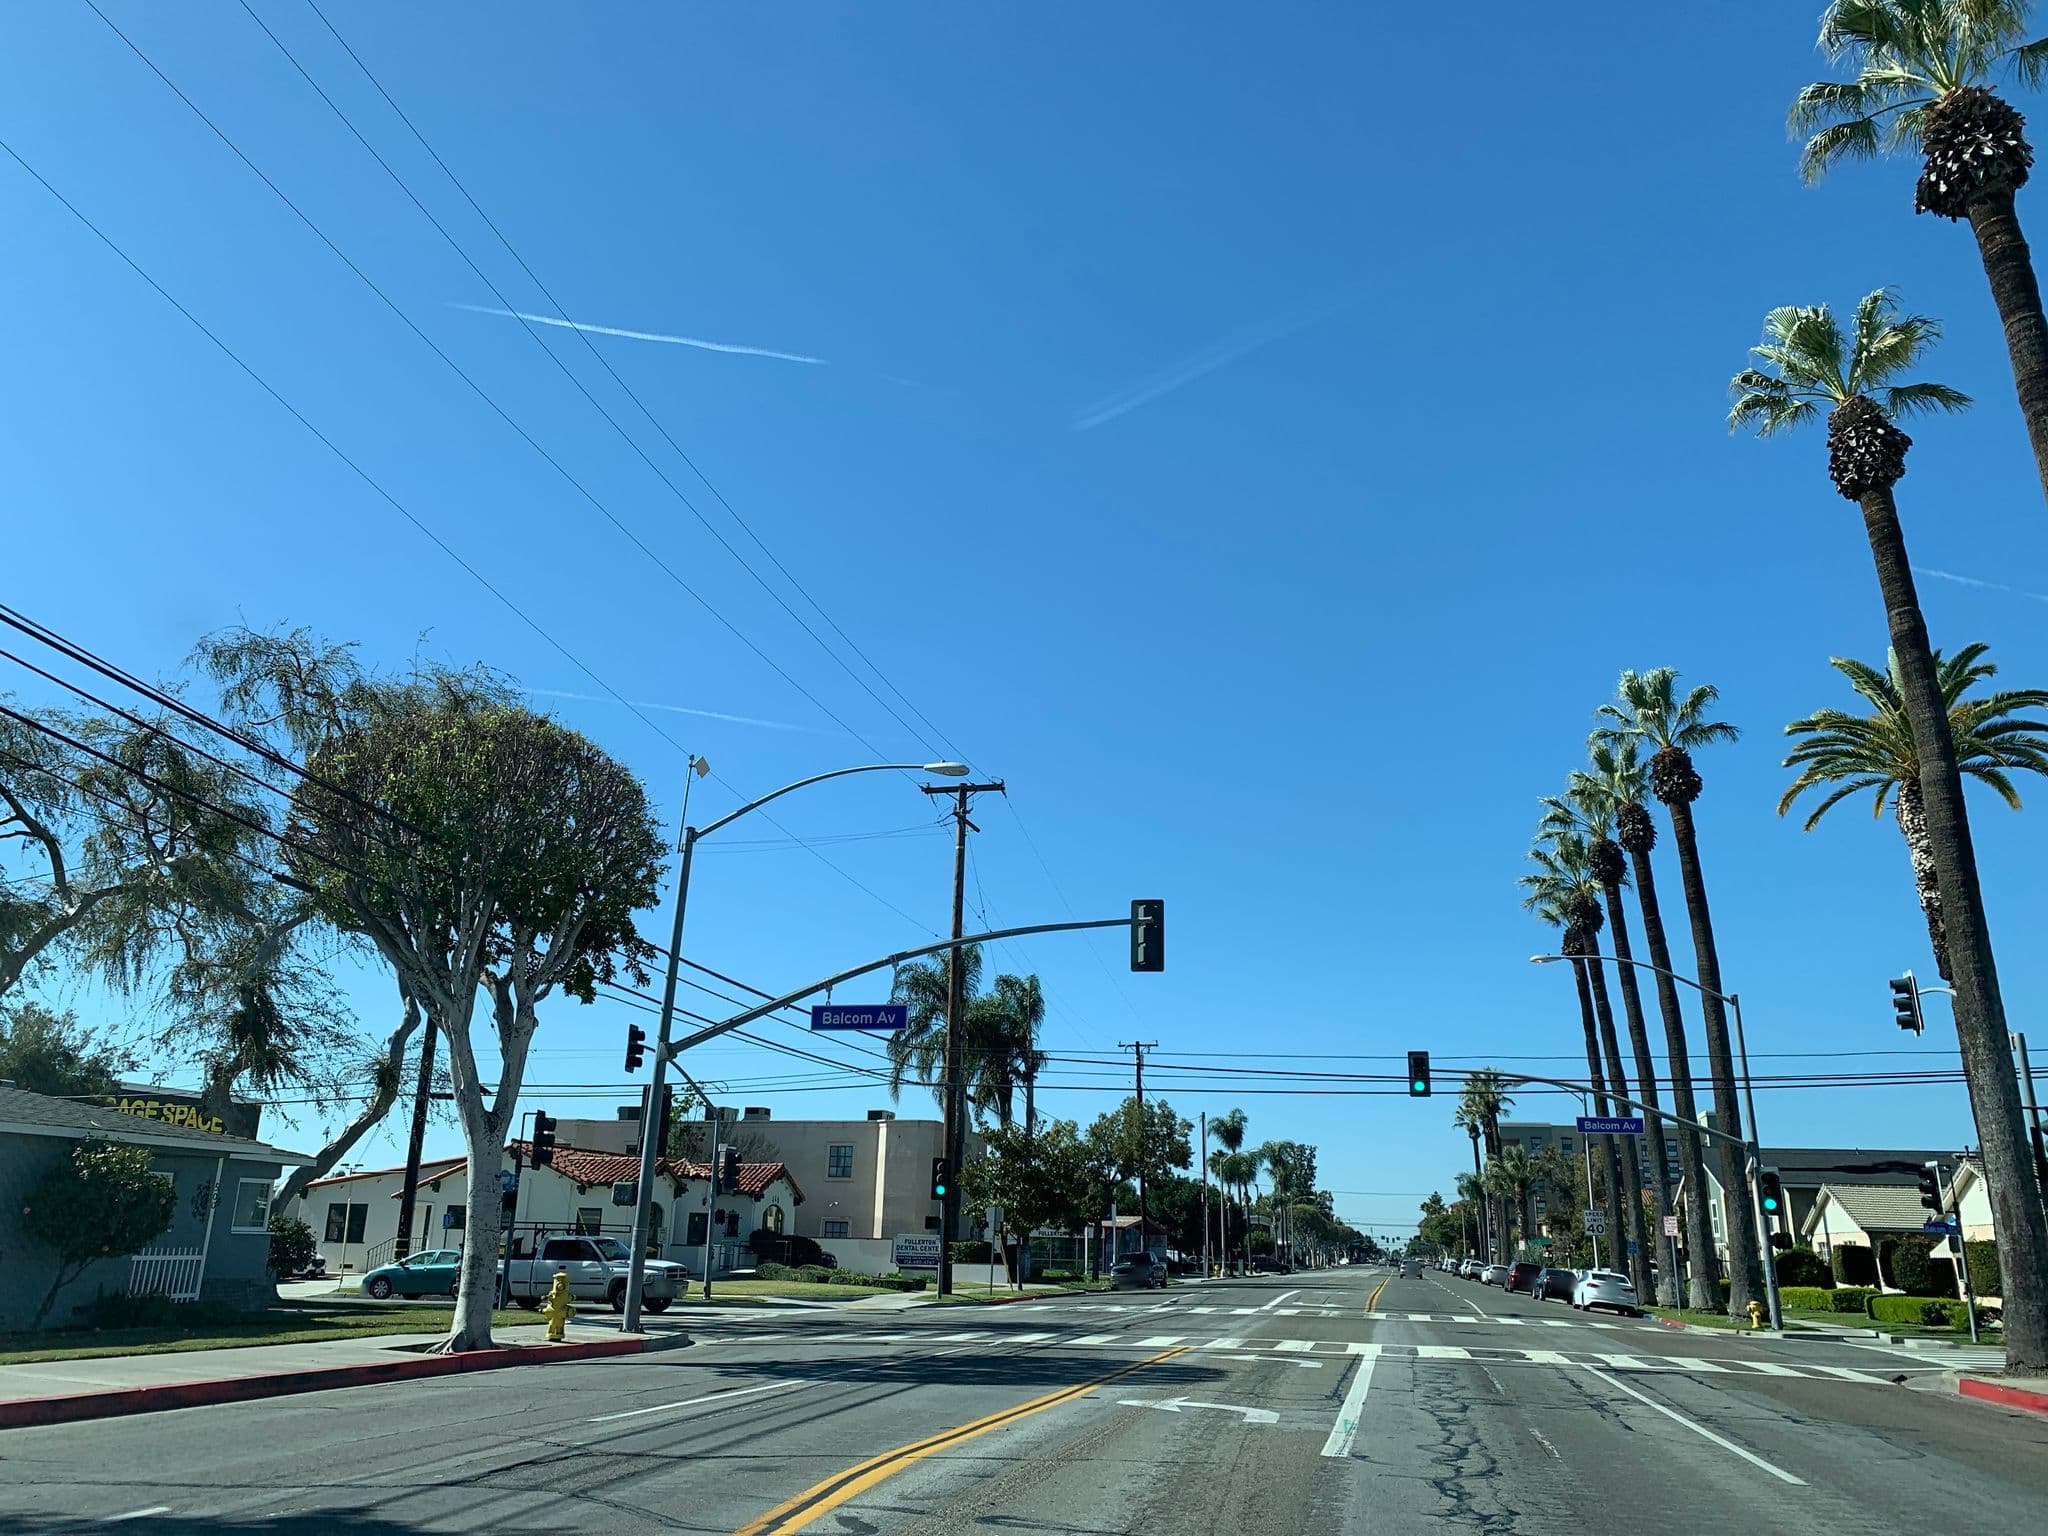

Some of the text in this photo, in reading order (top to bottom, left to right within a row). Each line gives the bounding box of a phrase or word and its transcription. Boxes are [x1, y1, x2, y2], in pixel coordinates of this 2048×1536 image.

[822, 1011, 896, 1024] Balcom Av
[160, 1102, 223, 1132] SPACE
[1584, 1121, 1636, 1130] Balcom Av
[1586, 1224, 1604, 1234] 40
